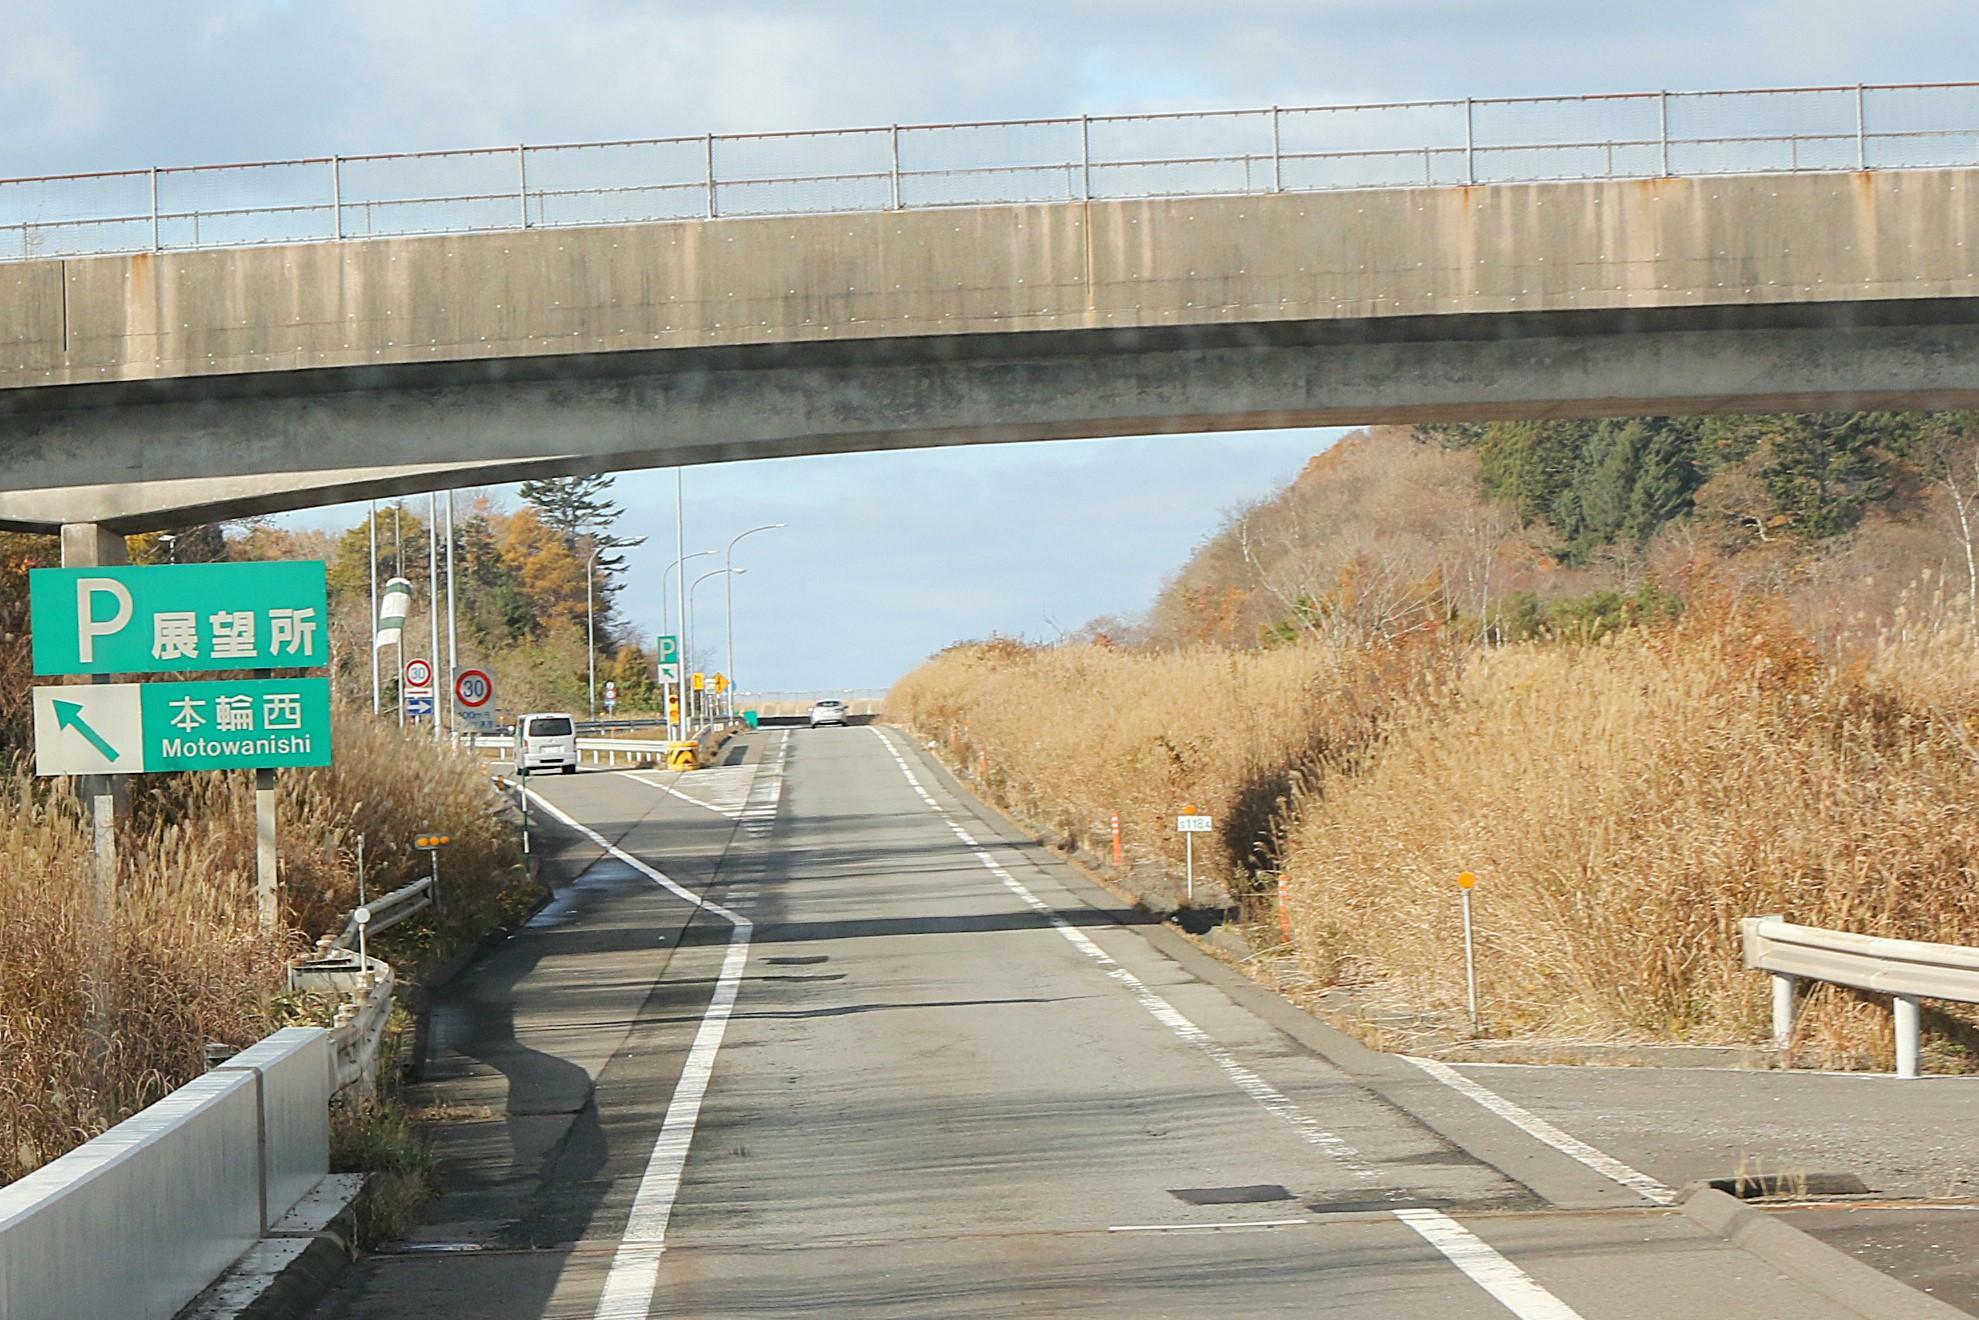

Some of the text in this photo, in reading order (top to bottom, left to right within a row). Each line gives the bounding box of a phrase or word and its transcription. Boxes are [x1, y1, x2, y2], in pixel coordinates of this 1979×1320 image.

[76, 577, 317, 663] P 展望所
[660, 639, 675, 662] P
[411, 666, 426, 680] 30
[463, 680, 484, 697] 30
[168, 693, 302, 733] 本輪西
[162, 734, 311, 758] Motowanishi
